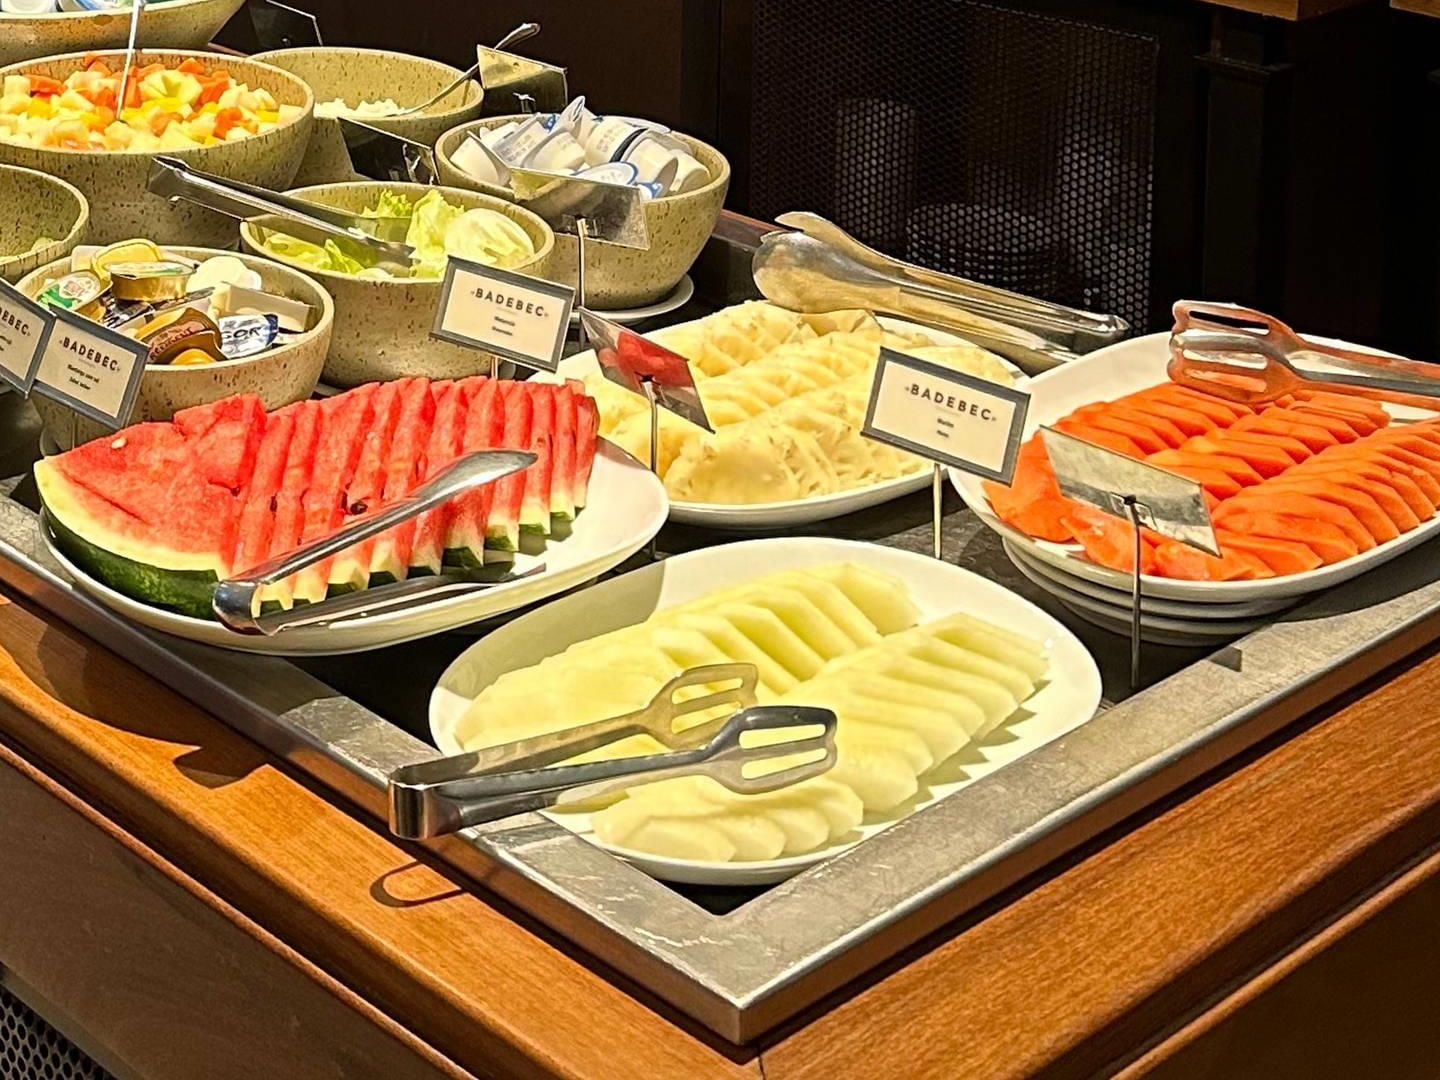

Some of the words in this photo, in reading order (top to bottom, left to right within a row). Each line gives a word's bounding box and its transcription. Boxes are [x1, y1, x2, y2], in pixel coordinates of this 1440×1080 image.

[475, 287, 544, 317] BADEBEC
[63, 336, 118, 371] BADEBEC
[910, 383, 991, 421] BADEBEC
